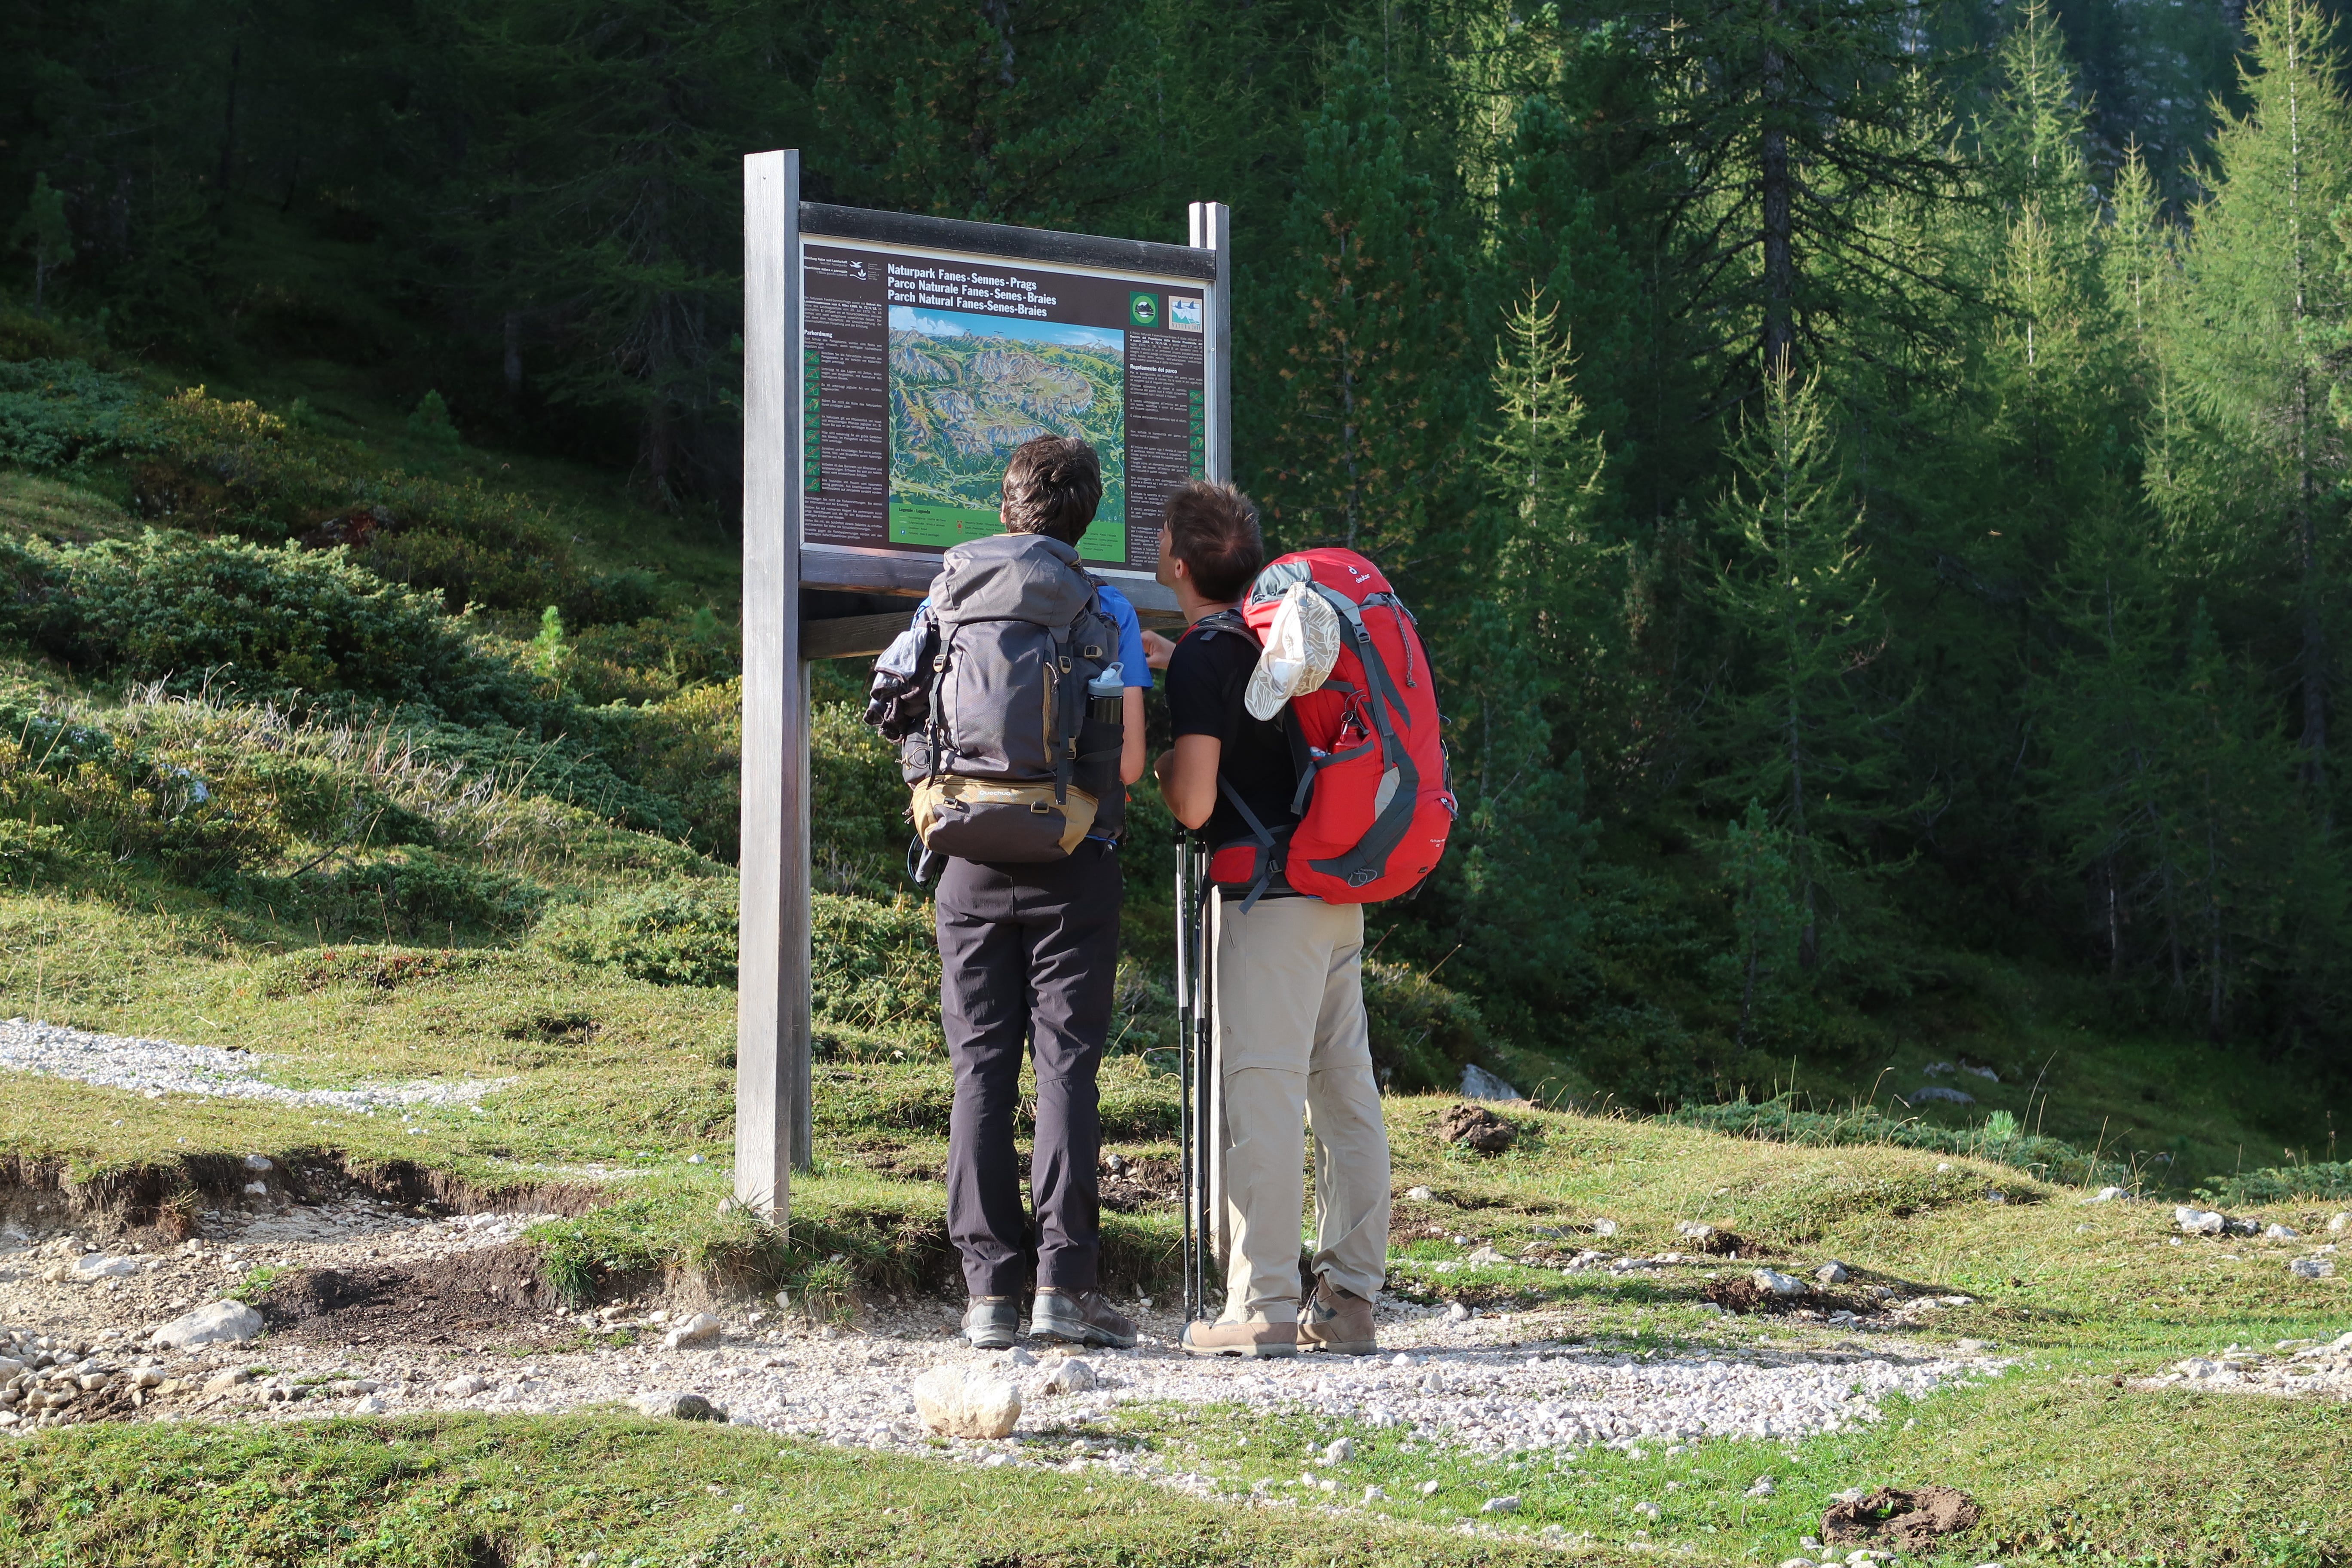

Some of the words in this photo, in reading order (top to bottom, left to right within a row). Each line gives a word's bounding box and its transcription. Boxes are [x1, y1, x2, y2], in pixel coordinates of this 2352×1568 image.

[888, 263, 935, 279] Naturpark
[888, 276, 915, 289] Parco
[919, 280, 959, 294] Naturale
[888, 289, 915, 303] Parch
[919, 293, 953, 306] Natural
[957, 297, 1047, 317] Fanes-Senes-Braies
[805, 330, 833, 338] Parkordnung
